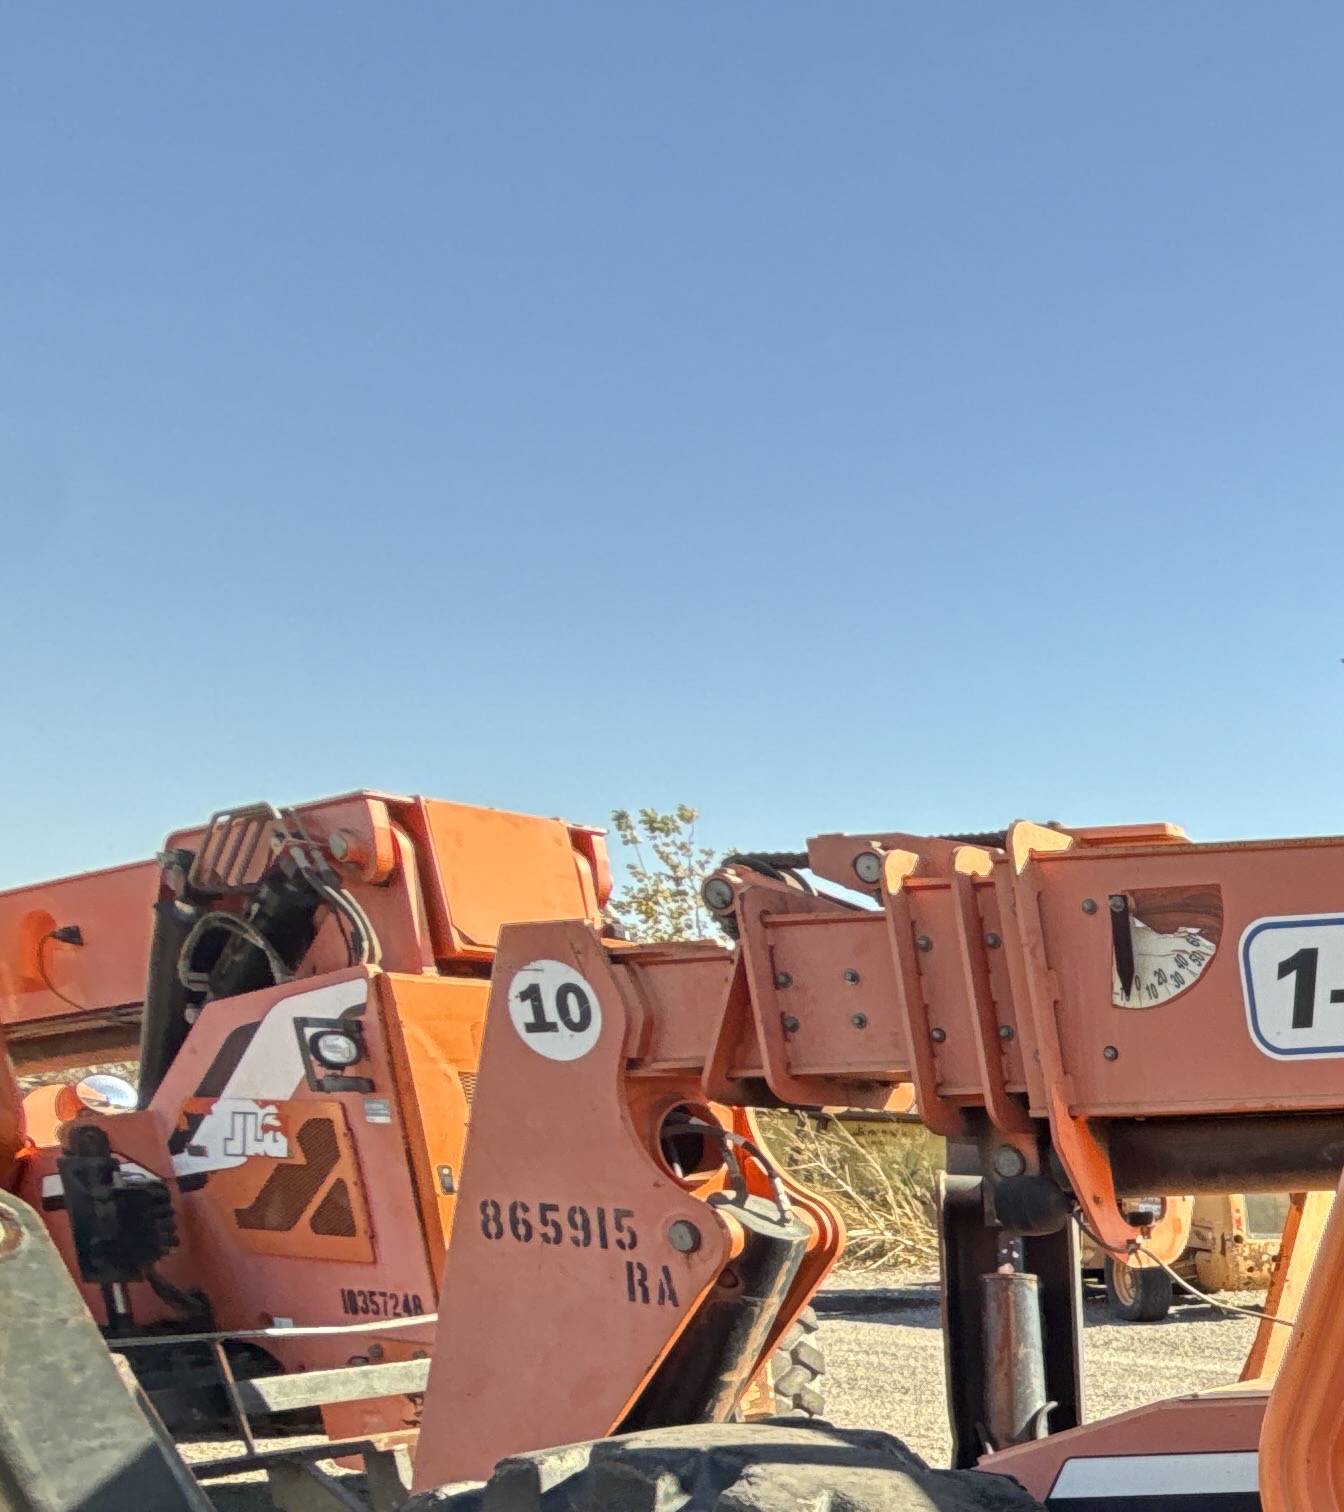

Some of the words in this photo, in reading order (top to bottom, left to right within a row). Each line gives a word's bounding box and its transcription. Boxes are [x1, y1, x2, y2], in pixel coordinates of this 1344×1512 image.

[1146, 983, 1158, 999] 10
[1154, 968, 1168, 985] 20
[1170, 971, 1185, 988] 30
[520, 982, 592, 1033] 10
[480, 1199, 638, 1251] 865915
[626, 1260, 679, 1307] RA
